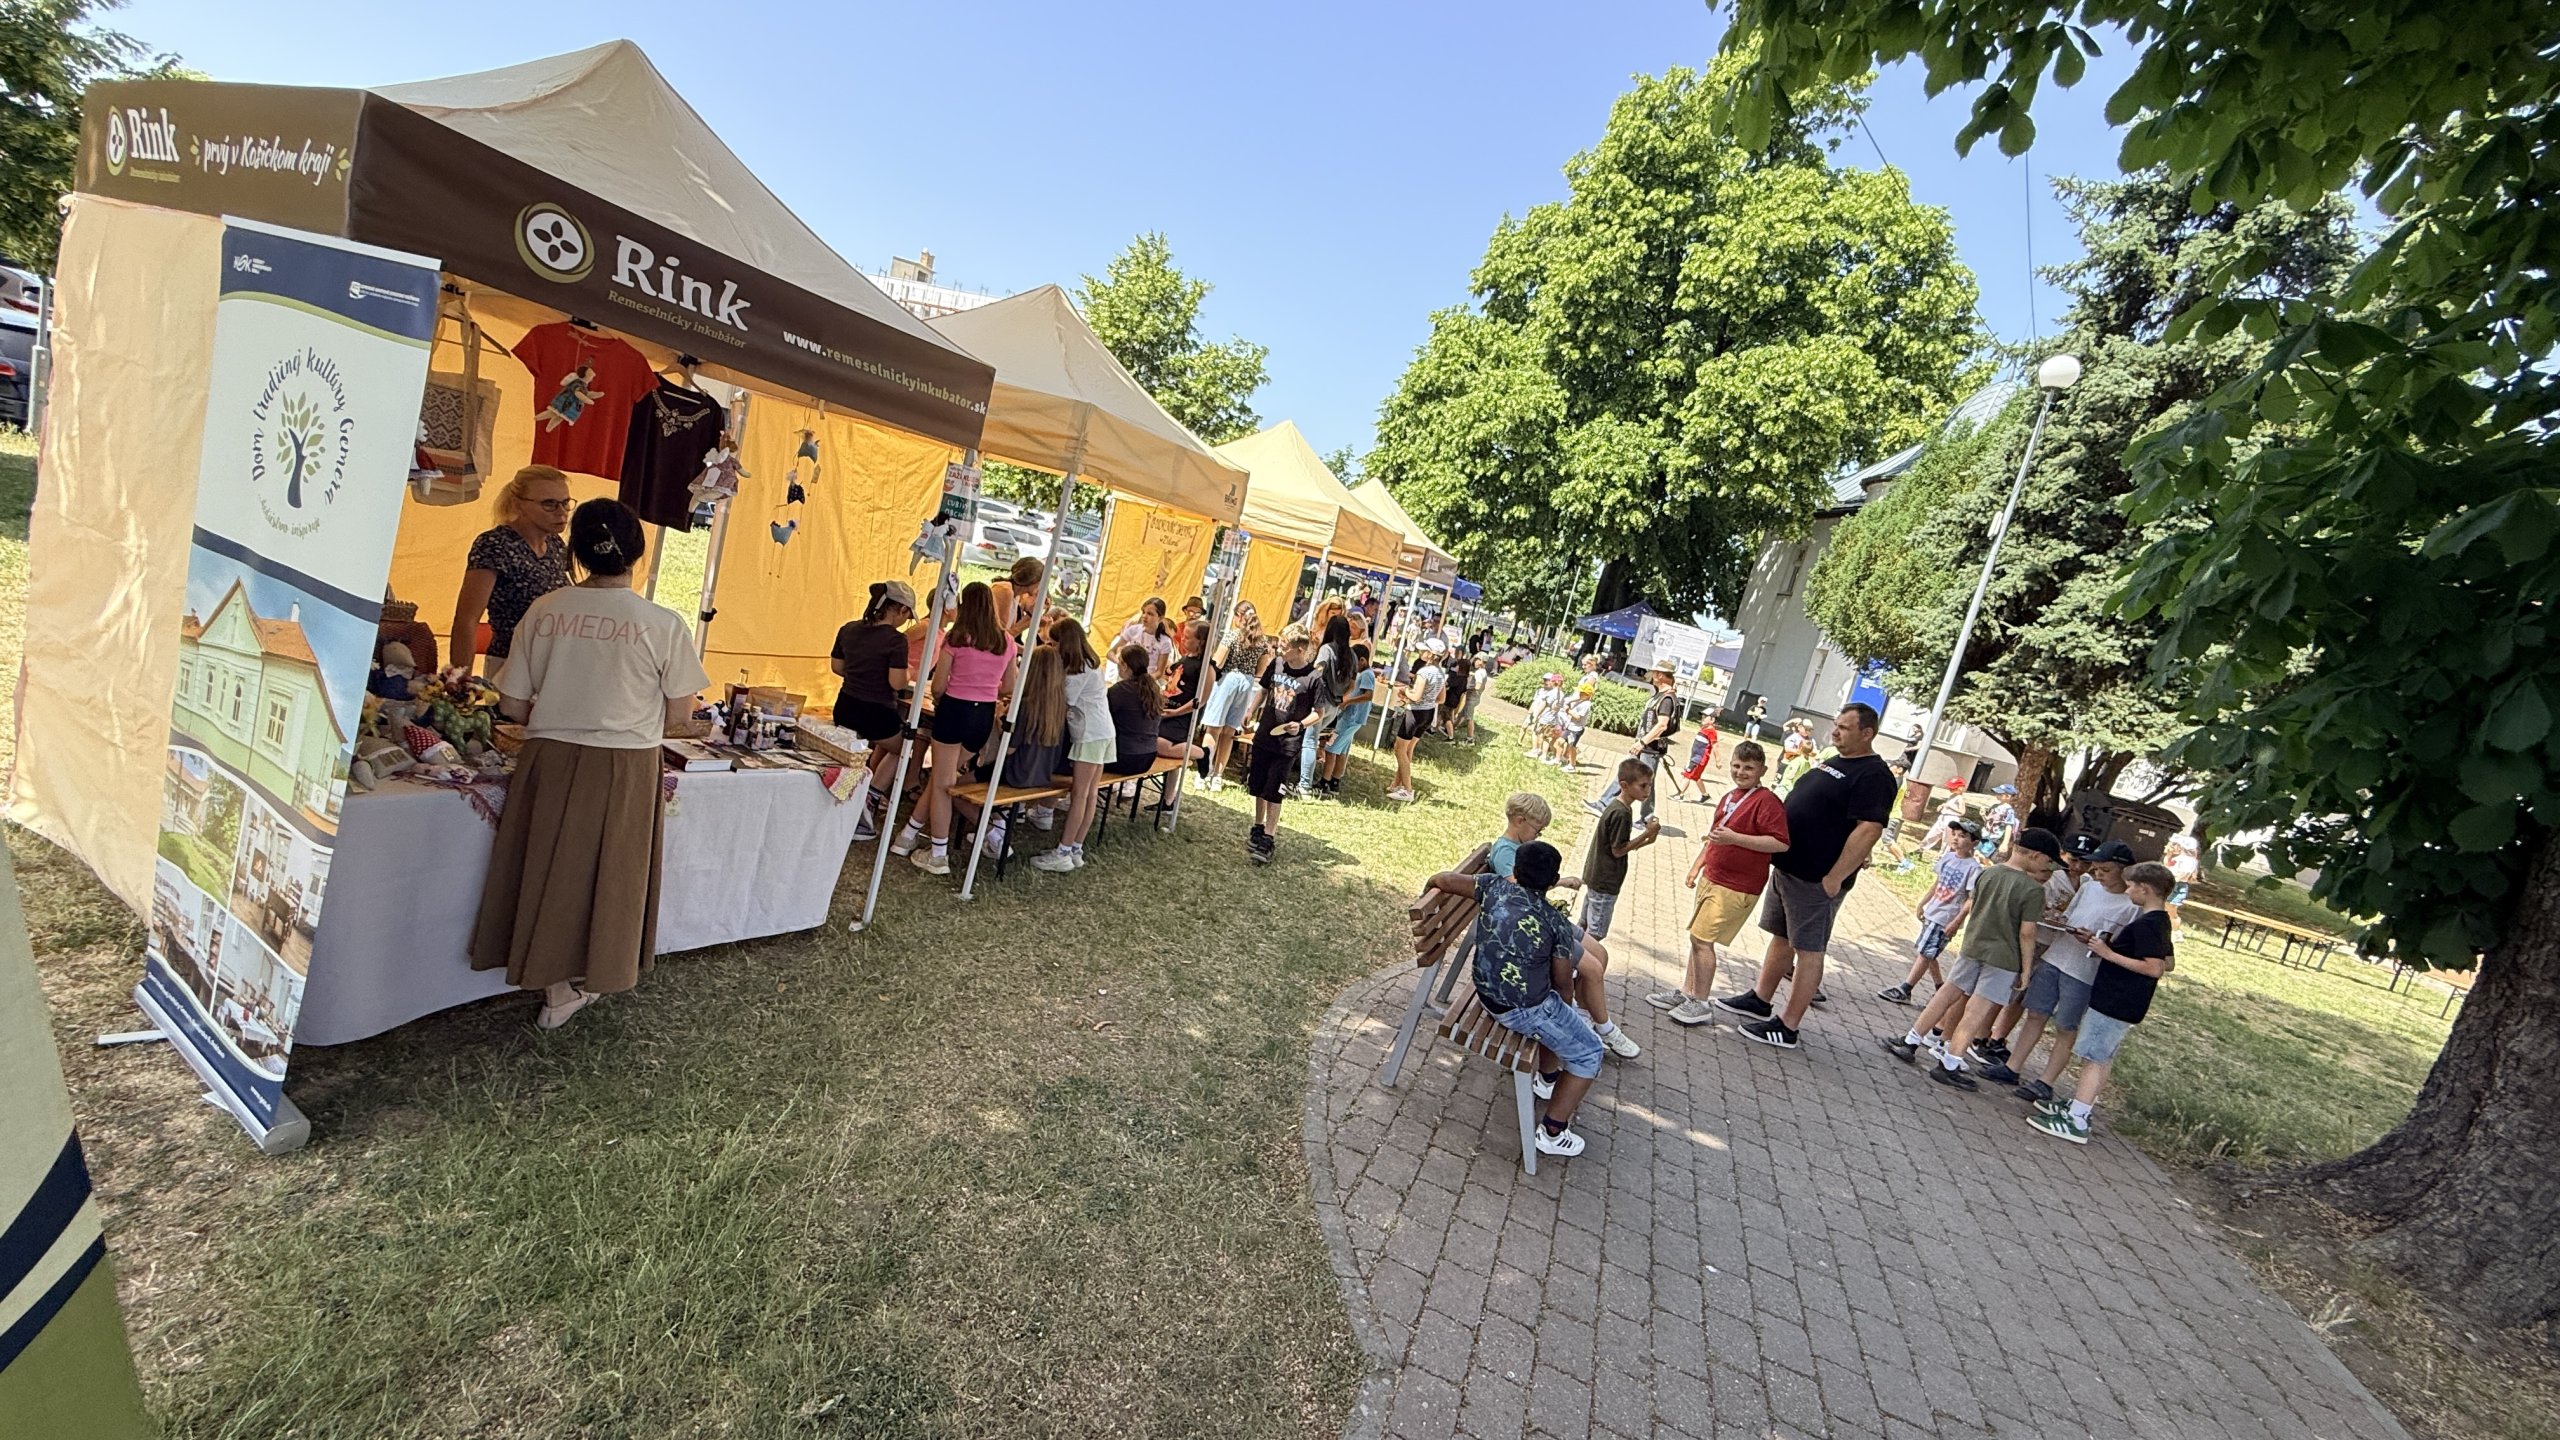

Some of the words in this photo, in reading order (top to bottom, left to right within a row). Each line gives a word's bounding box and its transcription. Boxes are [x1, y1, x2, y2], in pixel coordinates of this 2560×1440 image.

[126, 107, 180, 162] Rink
[203, 134, 230, 176] prvý
[231, 143, 240, 166] v
[239, 134, 298, 173] Košickom
[298, 137, 335, 187] kraji
[611, 233, 752, 333] Rink
[607, 289, 693, 331] Remeselnícky
[692, 322, 747, 350] inkubátor
[306, 346, 346, 412] kultúry
[782, 329, 988, 416] www.remeselnickyinkubator.sk
[252, 427, 267, 482] Dom
[324, 417, 355, 505] Gemera
